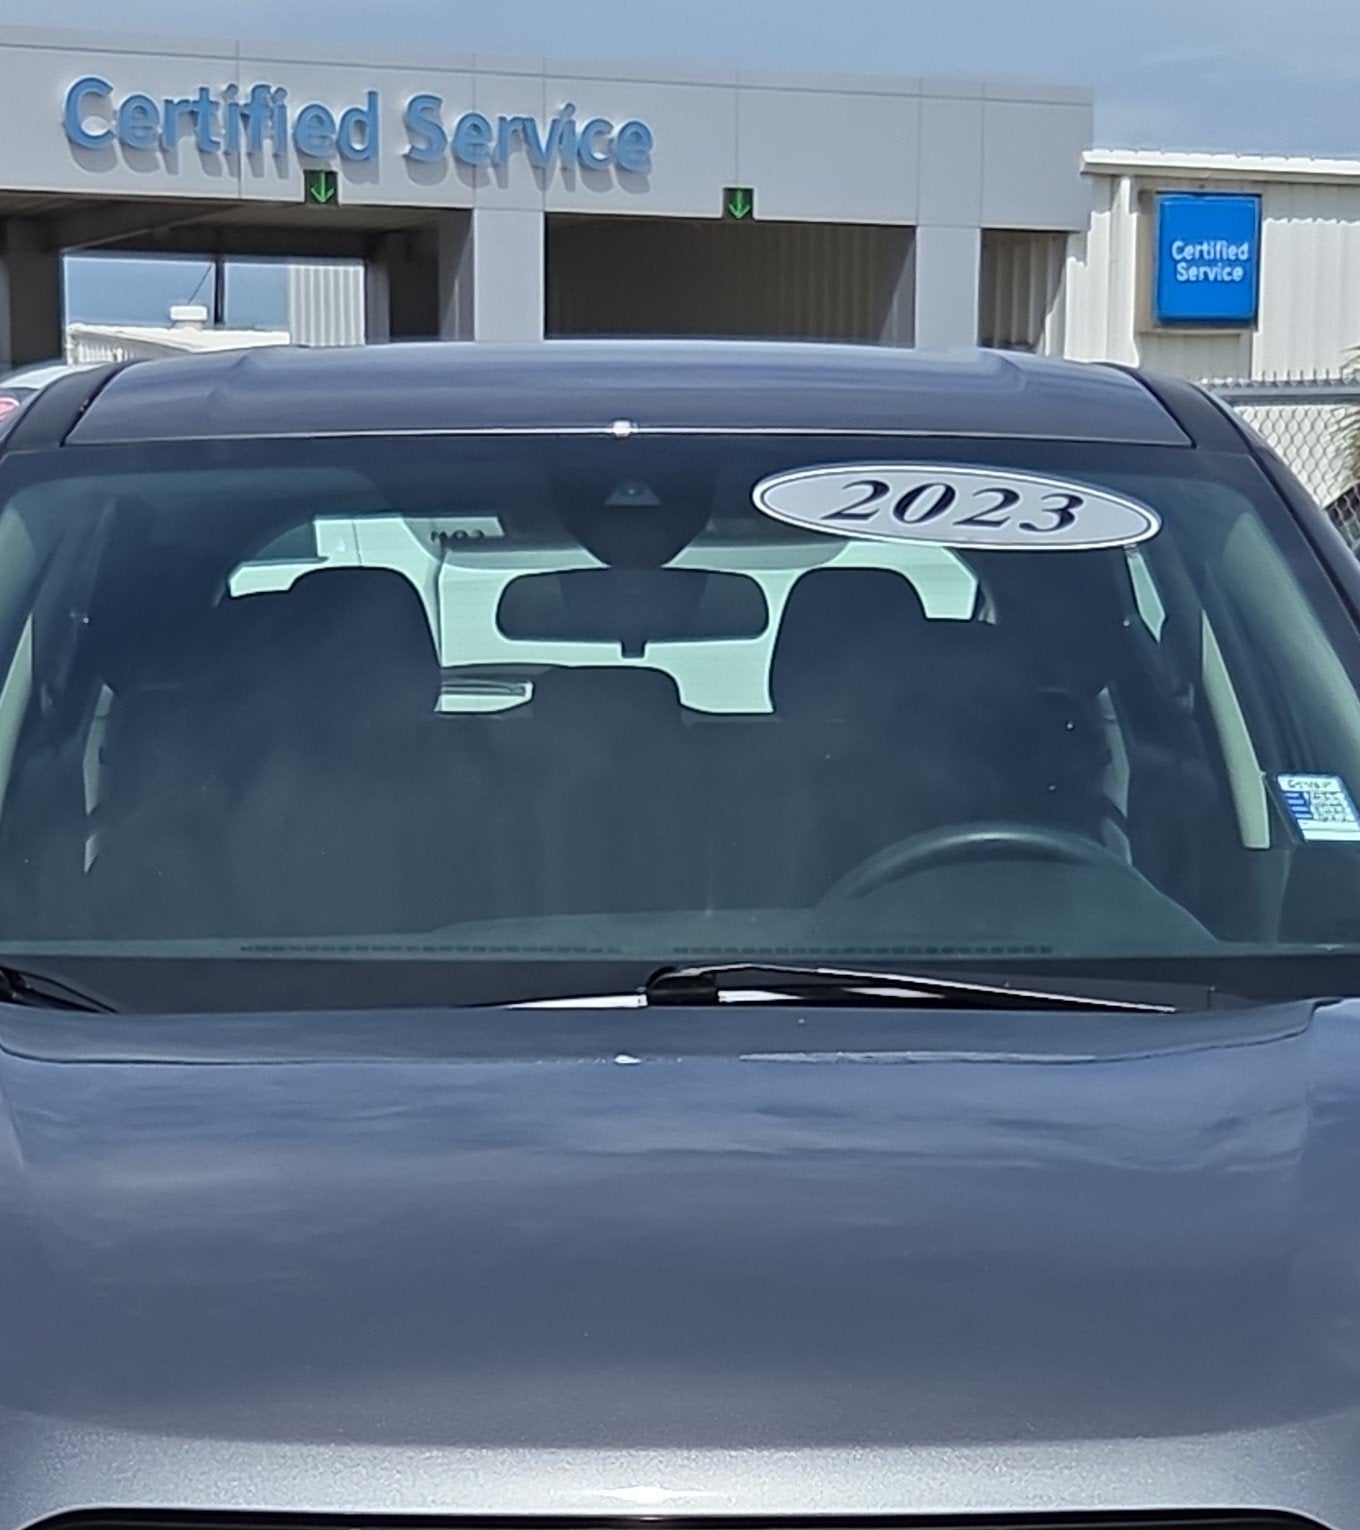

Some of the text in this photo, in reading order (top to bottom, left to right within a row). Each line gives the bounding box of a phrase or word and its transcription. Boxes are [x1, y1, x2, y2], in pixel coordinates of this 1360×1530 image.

[64, 77, 654, 176] Certified Service
[1171, 240, 1249, 260] Certified
[1176, 262, 1243, 282] Service
[820, 479, 1085, 532] 2023
